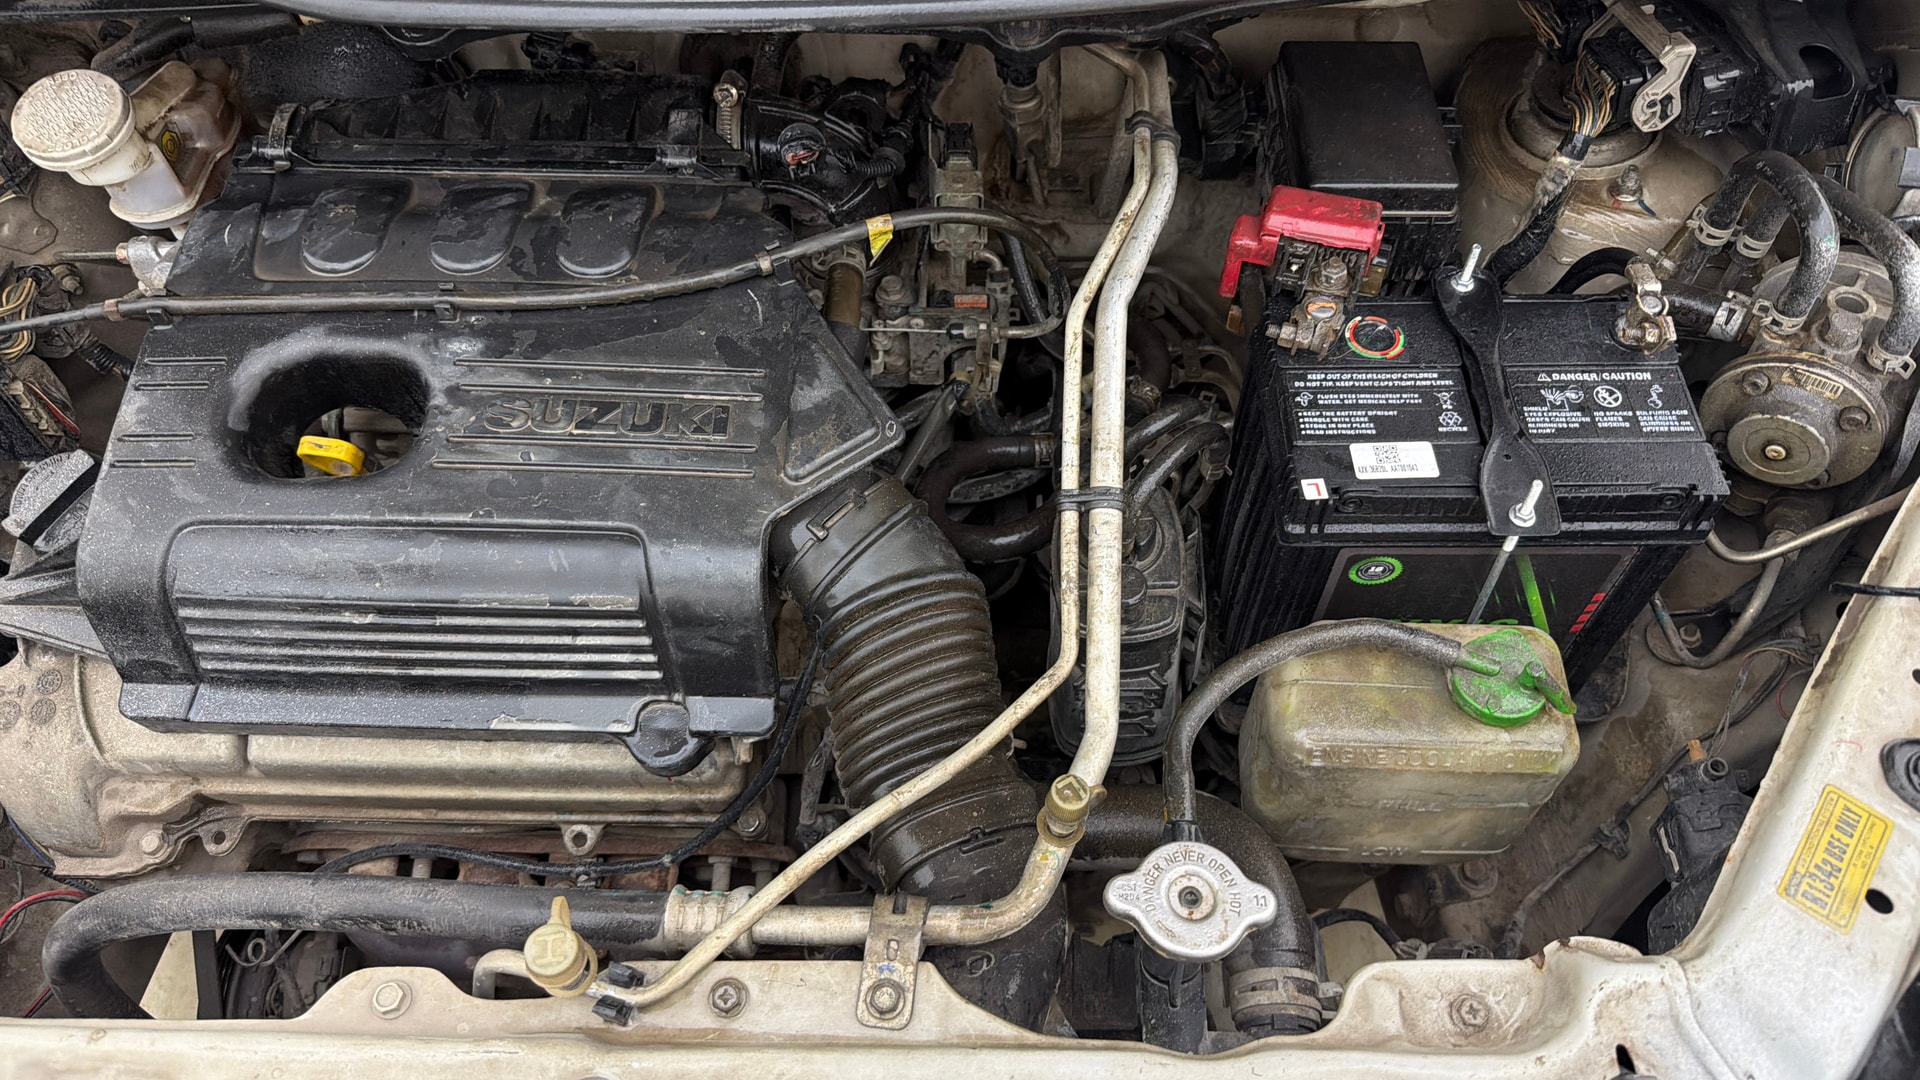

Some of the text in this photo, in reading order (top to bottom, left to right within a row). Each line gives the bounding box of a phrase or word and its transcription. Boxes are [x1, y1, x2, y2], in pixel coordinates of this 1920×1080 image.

[46, 72, 78, 86] OPEN
[48, 135, 88, 152] CLOSE
[1552, 372, 1651, 382] DANGER/CAUTION
[484, 399, 731, 439] SUZUKI
[1310, 748, 1388, 766] ENGINE
[1835, 804, 1863, 839] ONLY
[1360, 846, 1408, 857] LOW
[1823, 834, 1850, 863] USE
[1144, 850, 1242, 917] DANGER NEVER OPEN HOT
